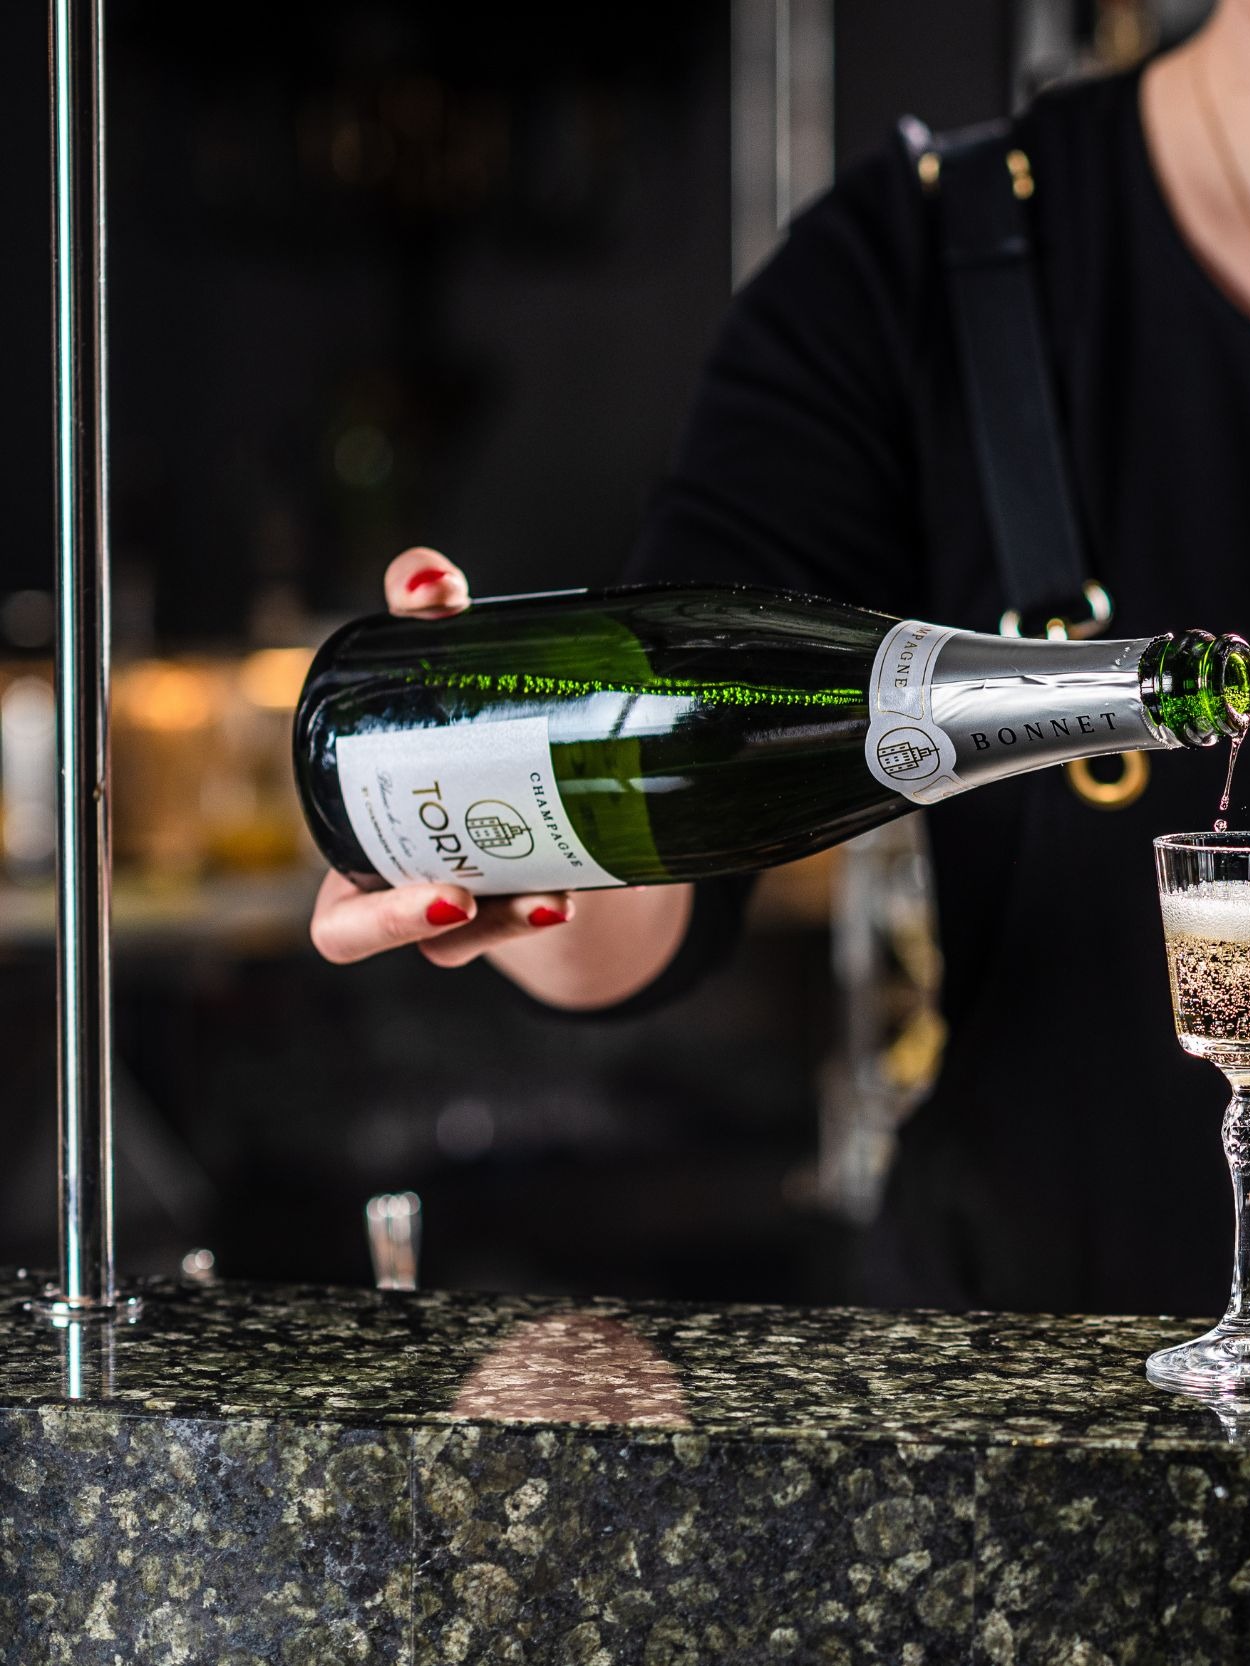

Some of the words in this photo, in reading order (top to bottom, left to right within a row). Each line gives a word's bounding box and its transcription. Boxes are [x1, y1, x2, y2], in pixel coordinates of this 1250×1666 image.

[970, 712, 1117, 751] BONNET
[412, 780, 485, 878] TORNI
[529, 772, 583, 868] CHAMPAGNE
